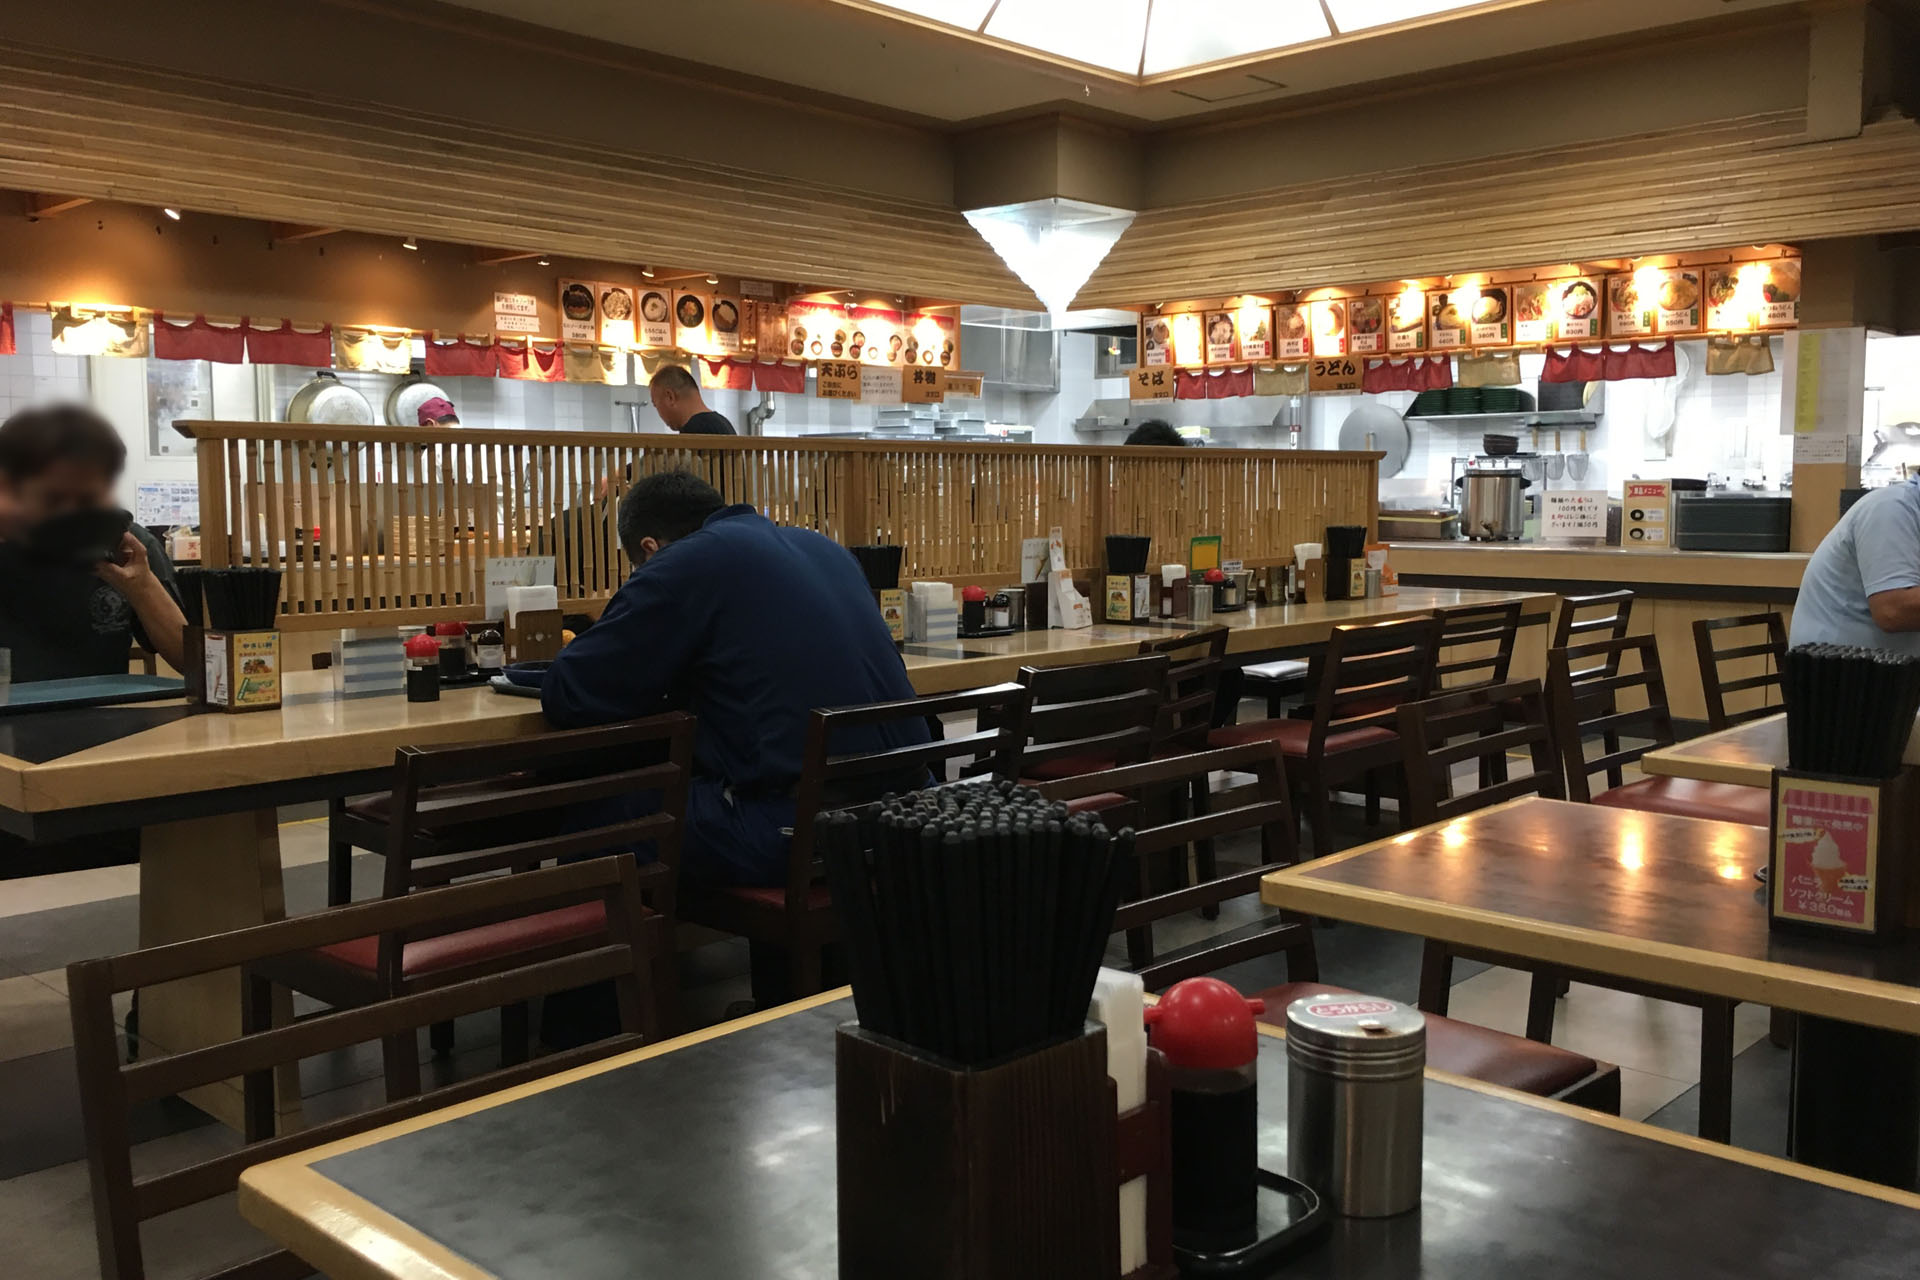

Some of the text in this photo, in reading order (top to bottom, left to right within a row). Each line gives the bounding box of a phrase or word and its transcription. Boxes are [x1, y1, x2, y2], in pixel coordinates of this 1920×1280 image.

[821, 362, 858, 380] 天ぷら
[913, 368, 937, 385] 丼物
[1314, 360, 1356, 377] うどん
[1138, 370, 1164, 386] そば
[1791, 874, 1822, 889] バニラ
[1789, 887, 1854, 906] ソフトクリーム
